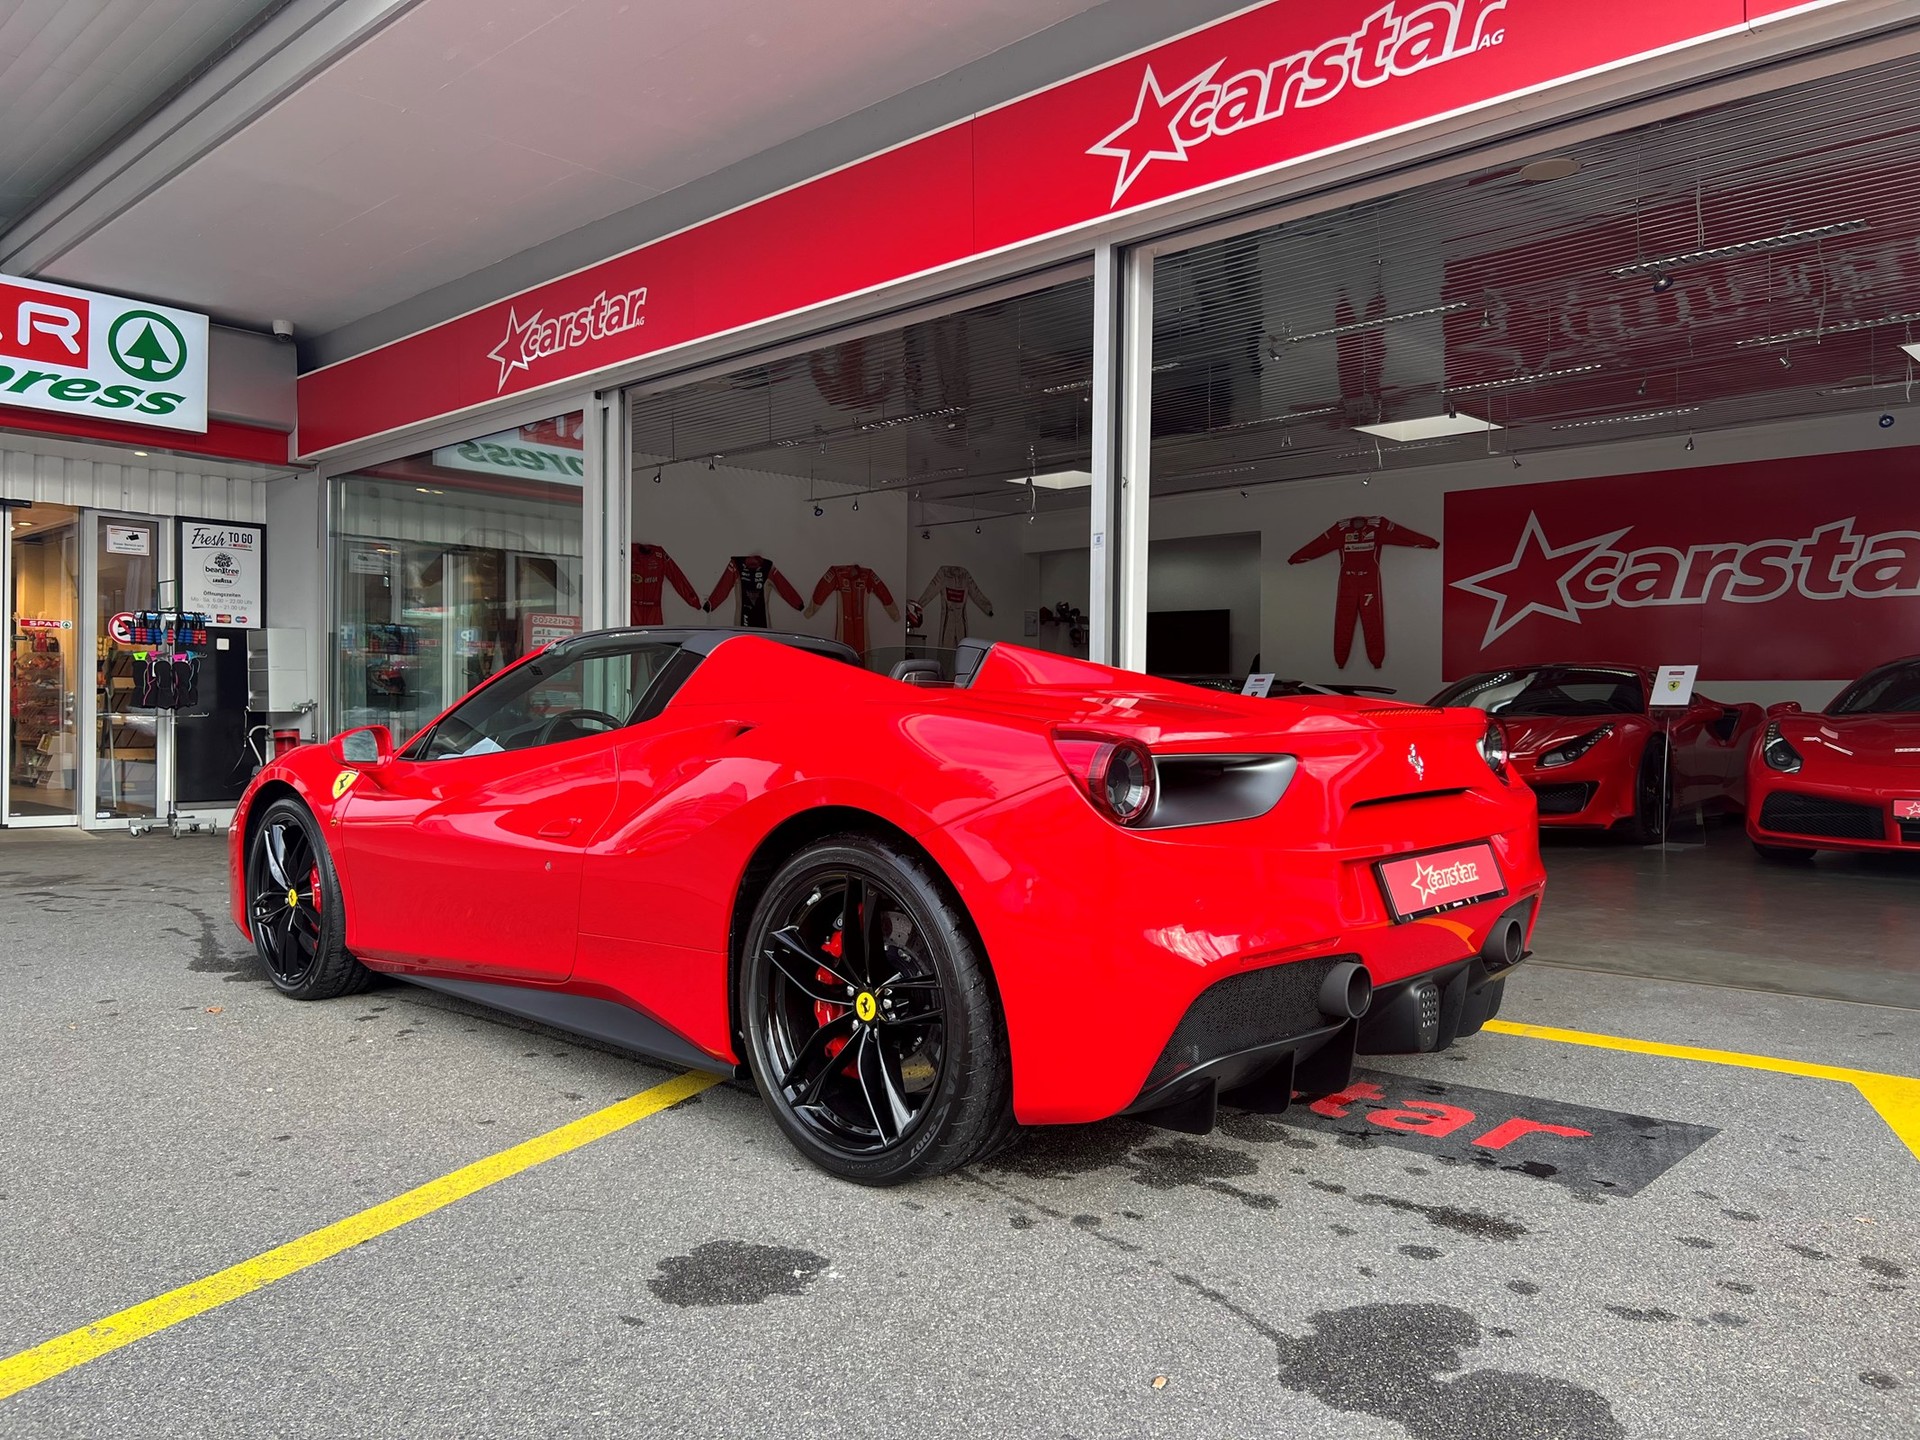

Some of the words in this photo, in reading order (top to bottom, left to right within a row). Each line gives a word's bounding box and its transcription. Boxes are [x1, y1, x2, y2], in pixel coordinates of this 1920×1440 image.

[1178, 0, 1507, 148] carstar
[1477, 28, 1506, 51] AG
[523, 286, 648, 362] carstar
[635, 316, 646, 327] AG
[192, 528, 226, 546] Fresh
[228, 531, 240, 543] TO
[241, 533, 253, 544] GO
[1363, 593, 1374, 606] 7
[1429, 861, 1479, 891] carstar
